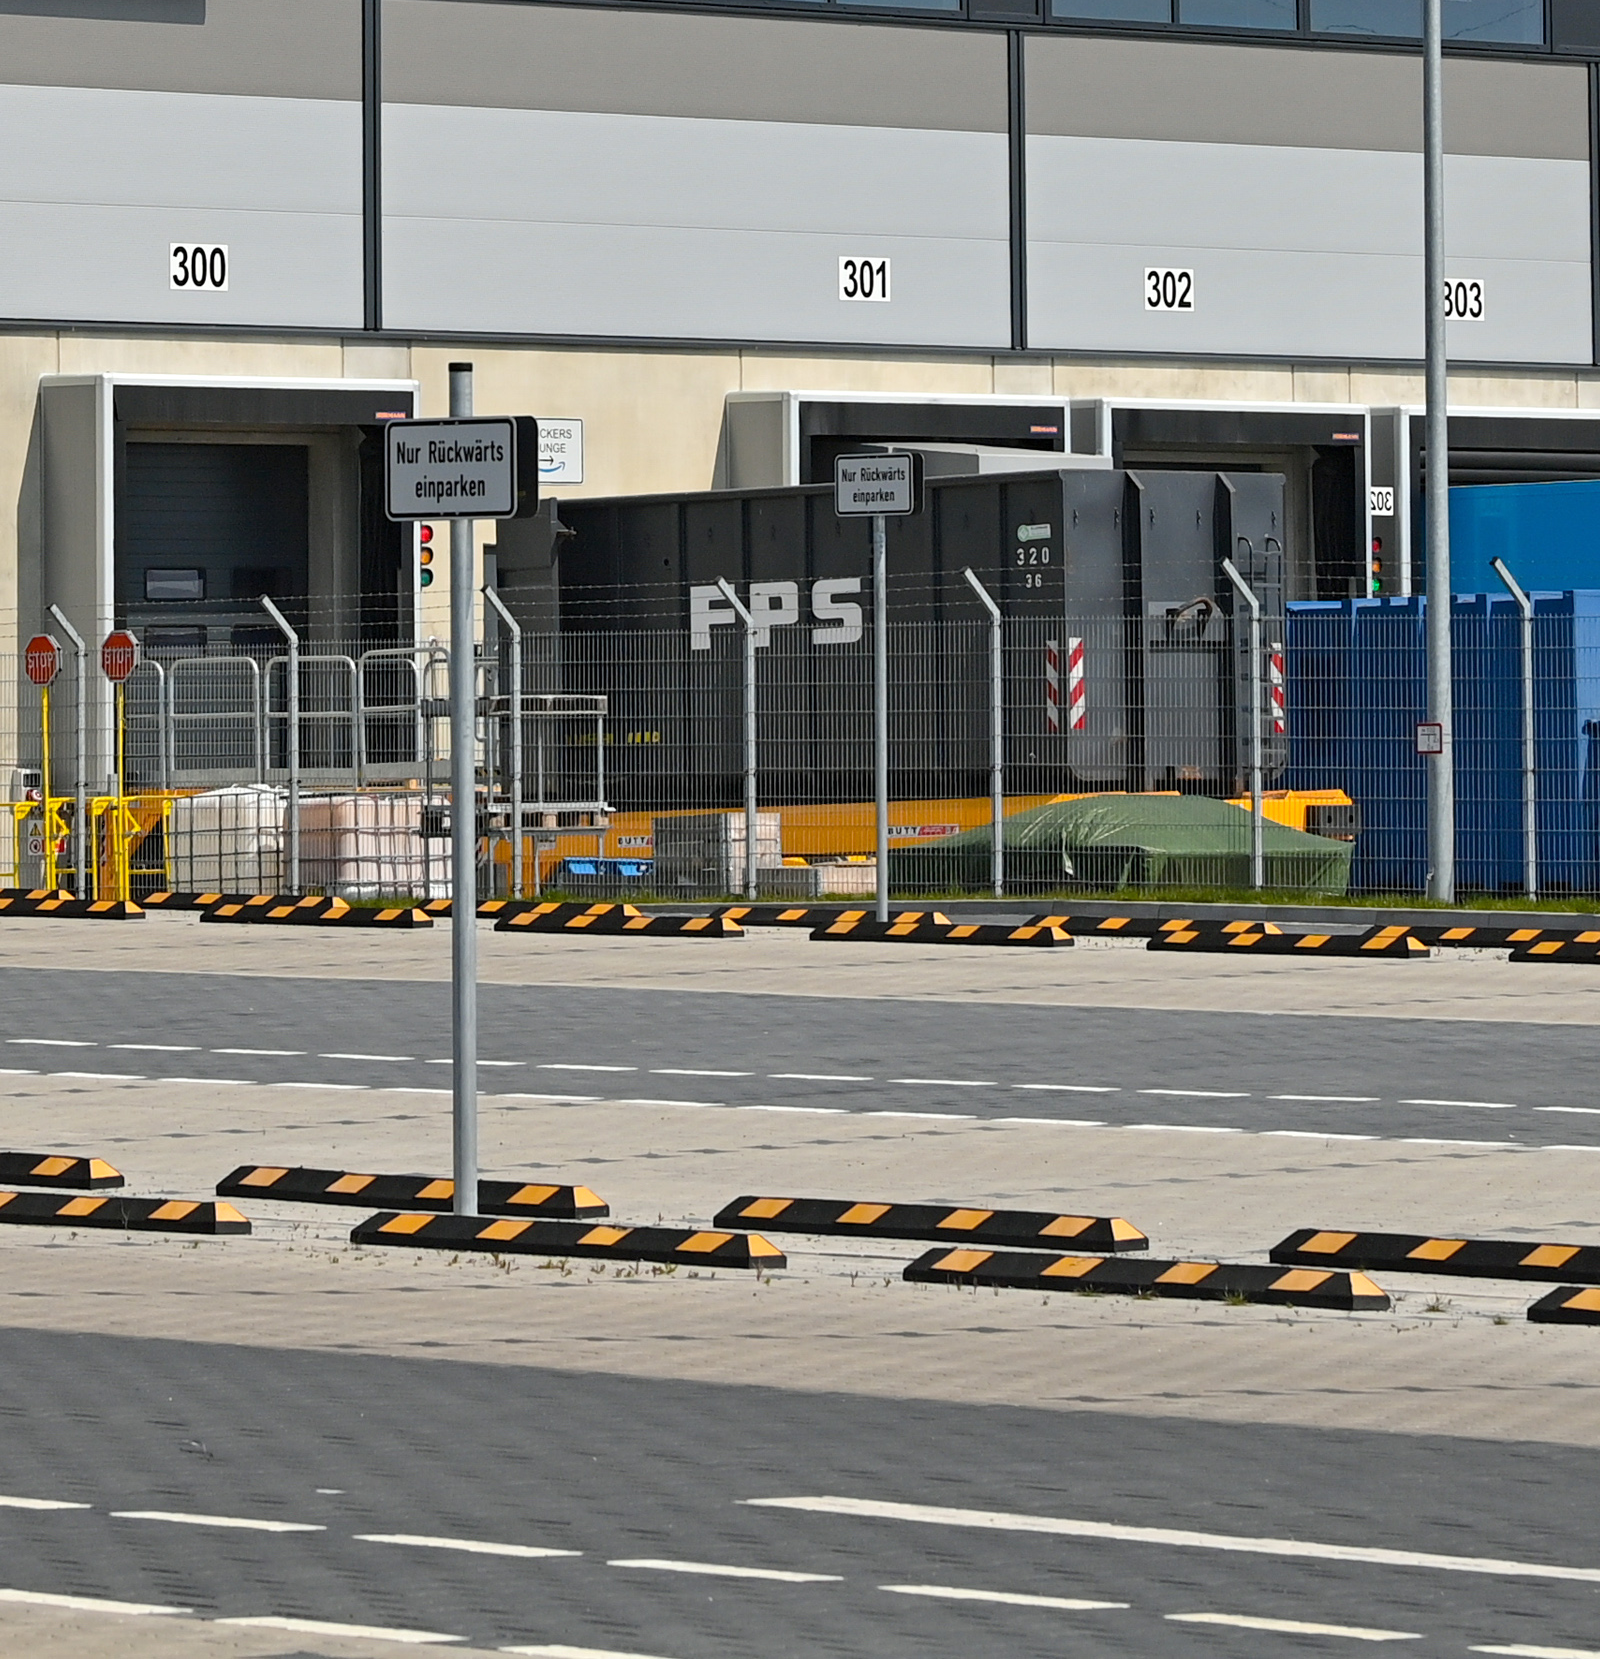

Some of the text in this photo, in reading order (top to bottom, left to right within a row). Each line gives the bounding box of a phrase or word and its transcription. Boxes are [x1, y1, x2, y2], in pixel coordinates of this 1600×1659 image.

[172, 246, 226, 287] 300
[843, 259, 886, 298] 301
[1146, 270, 1192, 308] 302
[1444, 281, 1483, 318] 303
[397, 439, 504, 464] Nur Rückwärts
[841, 467, 906, 482] Nur Rückwärts
[415, 474, 486, 503] einparken
[853, 488, 895, 506] einparken
[1016, 547, 1050, 565] 320
[1025, 573, 1042, 589] 36
[690, 578, 862, 650] FPS
[28, 652, 55, 668] STOP
[104, 650, 132, 664] STOP
[888, 827, 918, 835] BUTT
